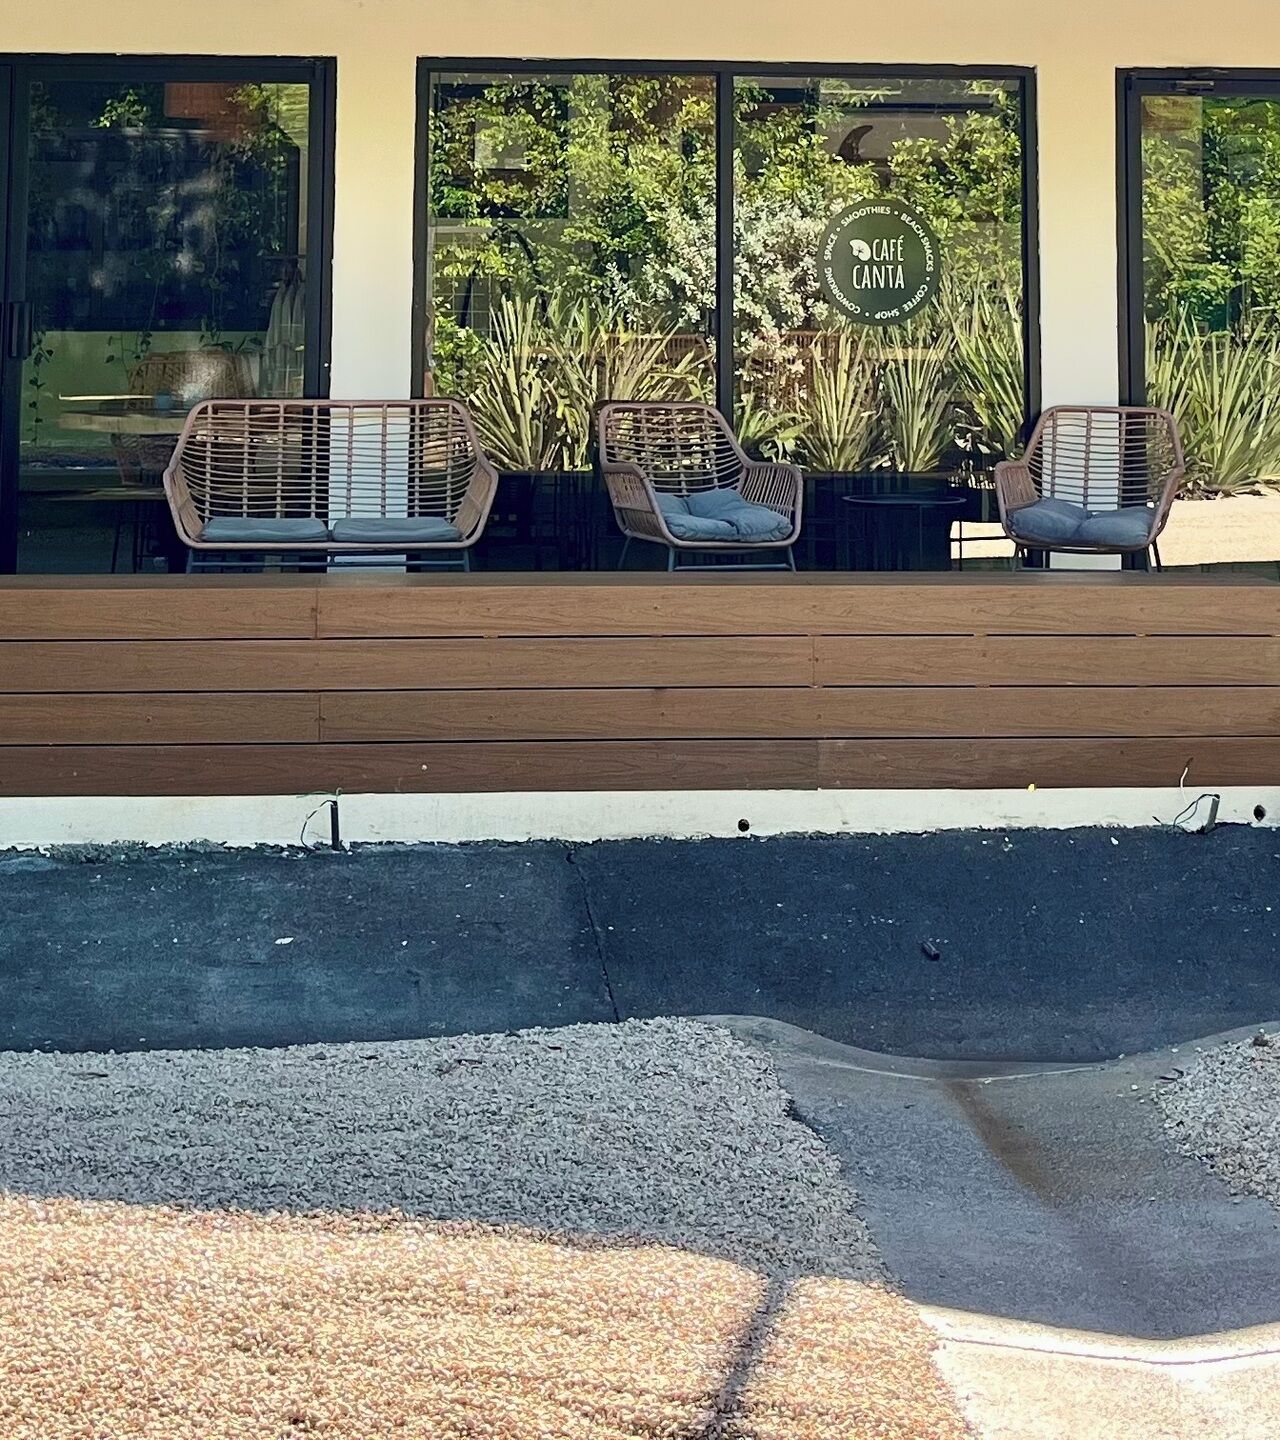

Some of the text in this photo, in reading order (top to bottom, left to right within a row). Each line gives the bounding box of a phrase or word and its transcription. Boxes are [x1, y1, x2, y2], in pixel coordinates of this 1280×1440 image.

[840, 206, 891, 227] SMOOTHIES
[872, 234, 905, 262] CAFÉ
[900, 213, 934, 272] BEACH SNACKS
[823, 232, 861, 314] COWORKING SPACE
[852, 264, 905, 290] CANTA
[874, 284, 928, 320] COFFEE SHOP
